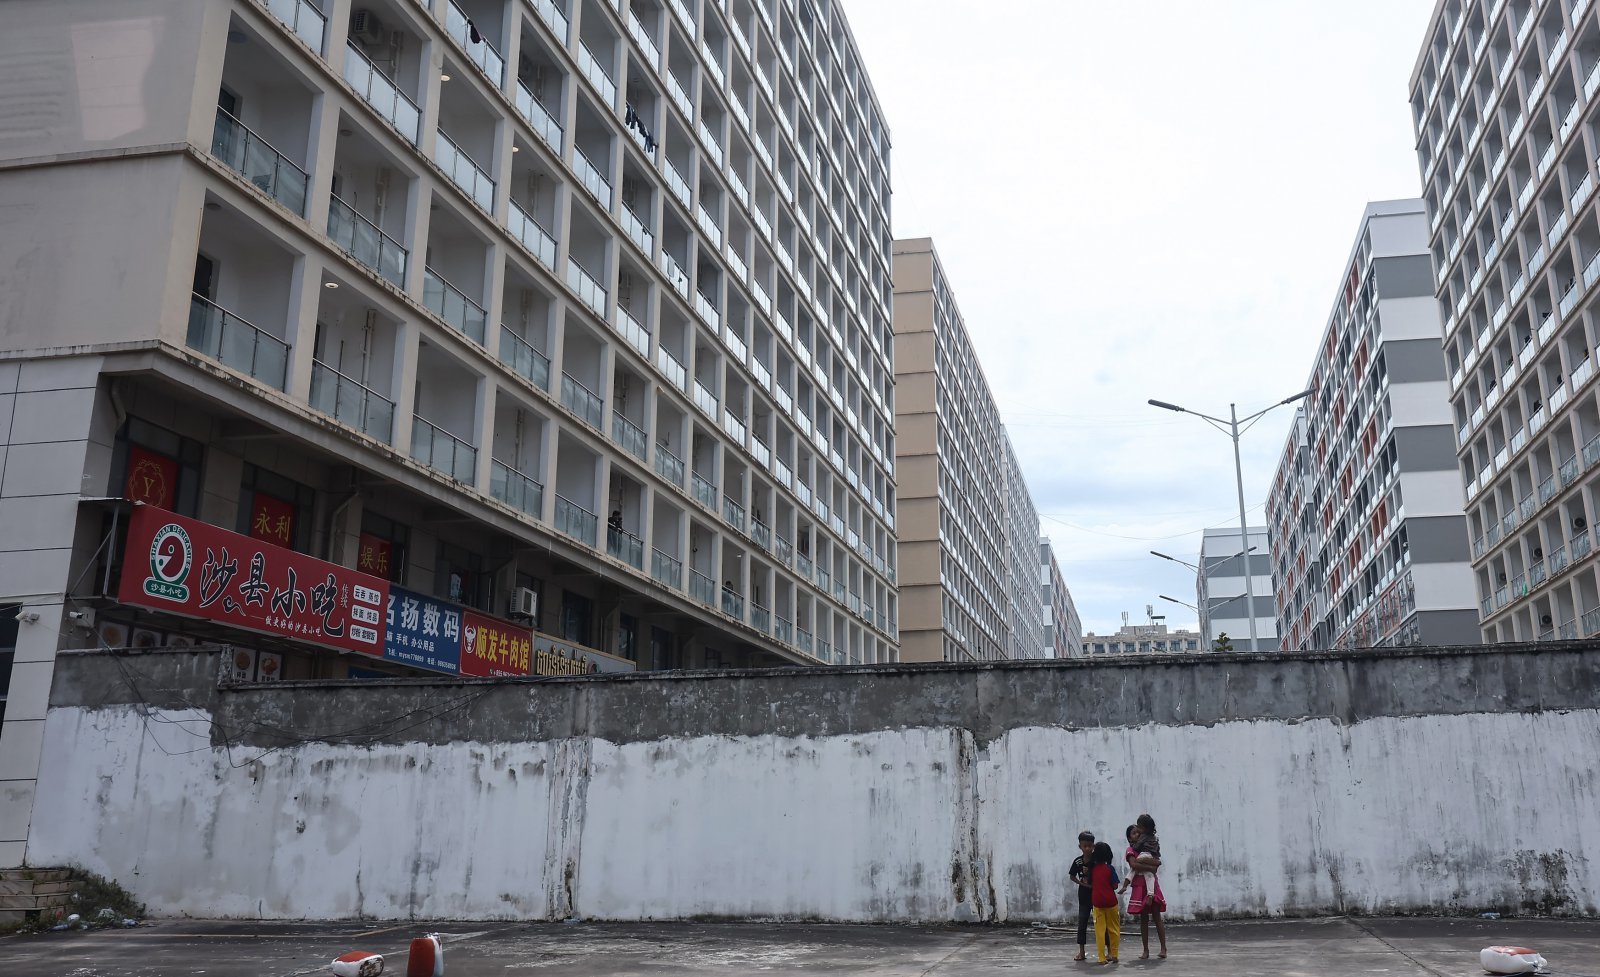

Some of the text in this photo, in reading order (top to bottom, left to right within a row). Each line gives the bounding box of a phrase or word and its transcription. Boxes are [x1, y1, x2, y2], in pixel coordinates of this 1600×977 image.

[255, 508, 291, 542] 永利
[361, 546, 388, 574] 娱乐
[150, 583, 183, 598] 沙县小吃
[199, 546, 345, 638] 沙县小吃
[265, 615, 322, 637] 做更好的沙县小吃
[396, 633, 409, 646] 手机
[411, 637, 435, 652] 办公用品
[475, 625, 530, 671] 顺发牛肉馆
